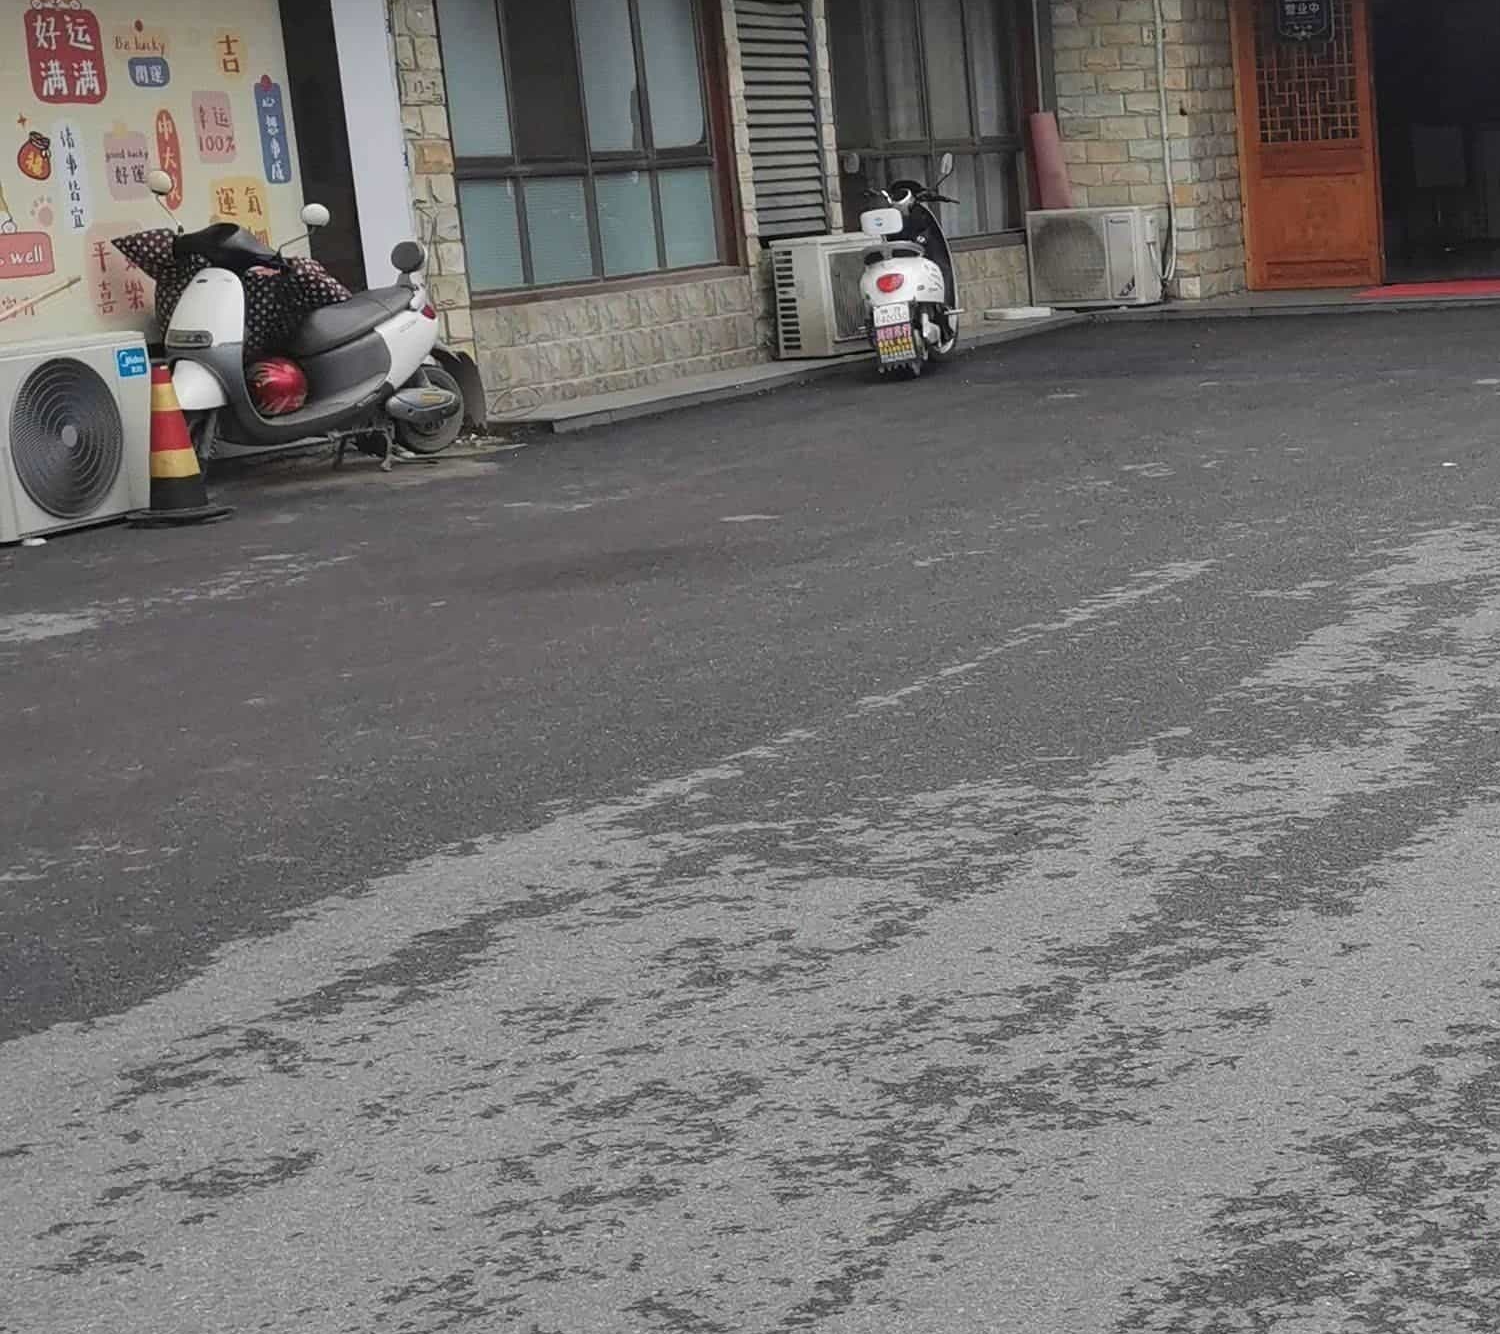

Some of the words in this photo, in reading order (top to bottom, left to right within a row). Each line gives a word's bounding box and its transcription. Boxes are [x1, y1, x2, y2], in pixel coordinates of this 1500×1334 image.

[32, 14, 95, 50] 好运
[217, 34, 241, 74] 吉
[40, 60, 101, 97] 满满
[10, 245, 43, 264] well
